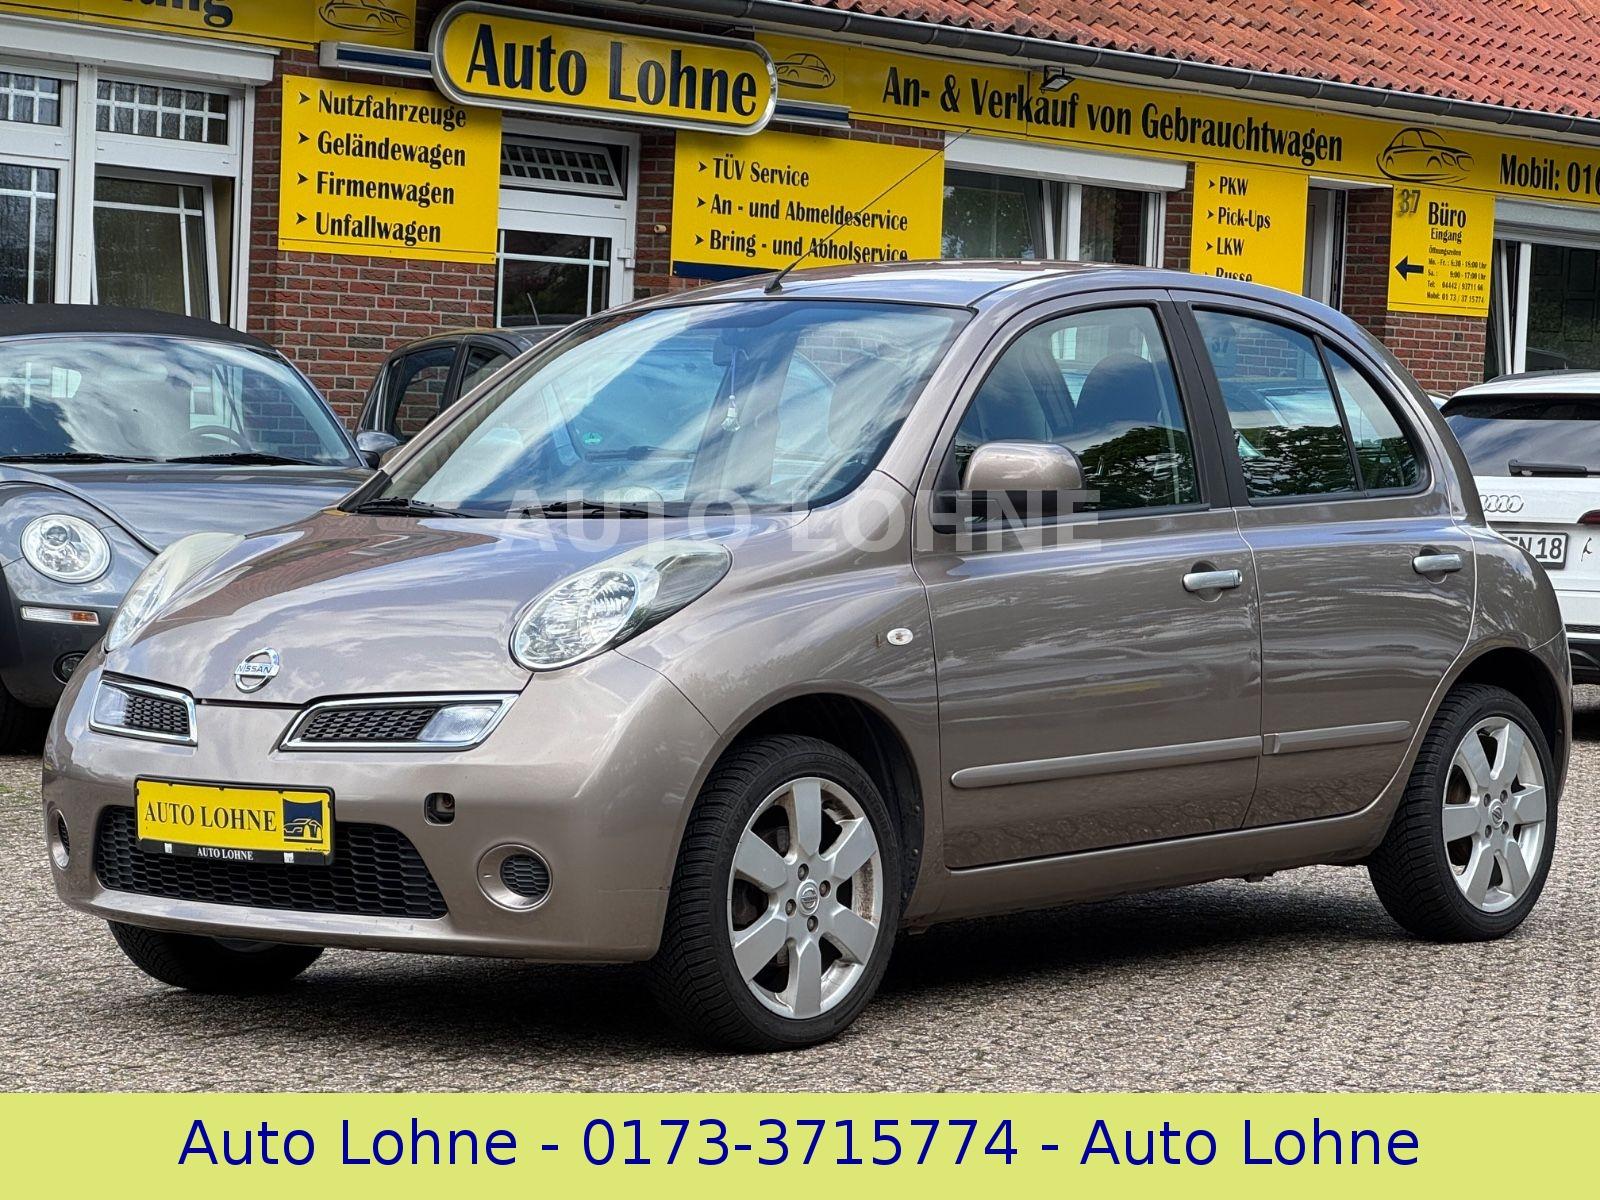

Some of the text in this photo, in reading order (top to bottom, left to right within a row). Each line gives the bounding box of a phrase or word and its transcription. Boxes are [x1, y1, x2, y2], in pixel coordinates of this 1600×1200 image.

[465, 23, 758, 117] Auto Lohne
[318, 89, 467, 132] Nutzfahrzeuge
[882, 65, 1344, 167] An- & Verkauf von Gebrauchtwagen
[317, 129, 466, 169] Geländewagen
[713, 154, 809, 187] TÜV Service
[1219, 176, 1249, 196] PKW
[1500, 153, 1560, 191] Mobil:
[316, 170, 455, 207] Firmenwagen
[1400, 189, 1421, 214] 37
[711, 193, 732, 215] An
[749, 199, 780, 219] und
[785, 200, 908, 231] Abmeldeservice
[1218, 207, 1271, 231] Pick-Ups
[1428, 201, 1467, 228] Büro
[315, 210, 441, 247] Unfallwagen
[1431, 228, 1462, 244] Eingang
[710, 229, 756, 257] Bring
[772, 237, 803, 256] und
[808, 237, 908, 263] Abholservice
[1217, 237, 1244, 256] LKW
[1535, 537, 1563, 560] 18
[236, 664, 274, 674] NISSAN
[144, 801, 277, 832] AUTO LOHNE
[197, 847, 254, 861] AUTO LOHNE
